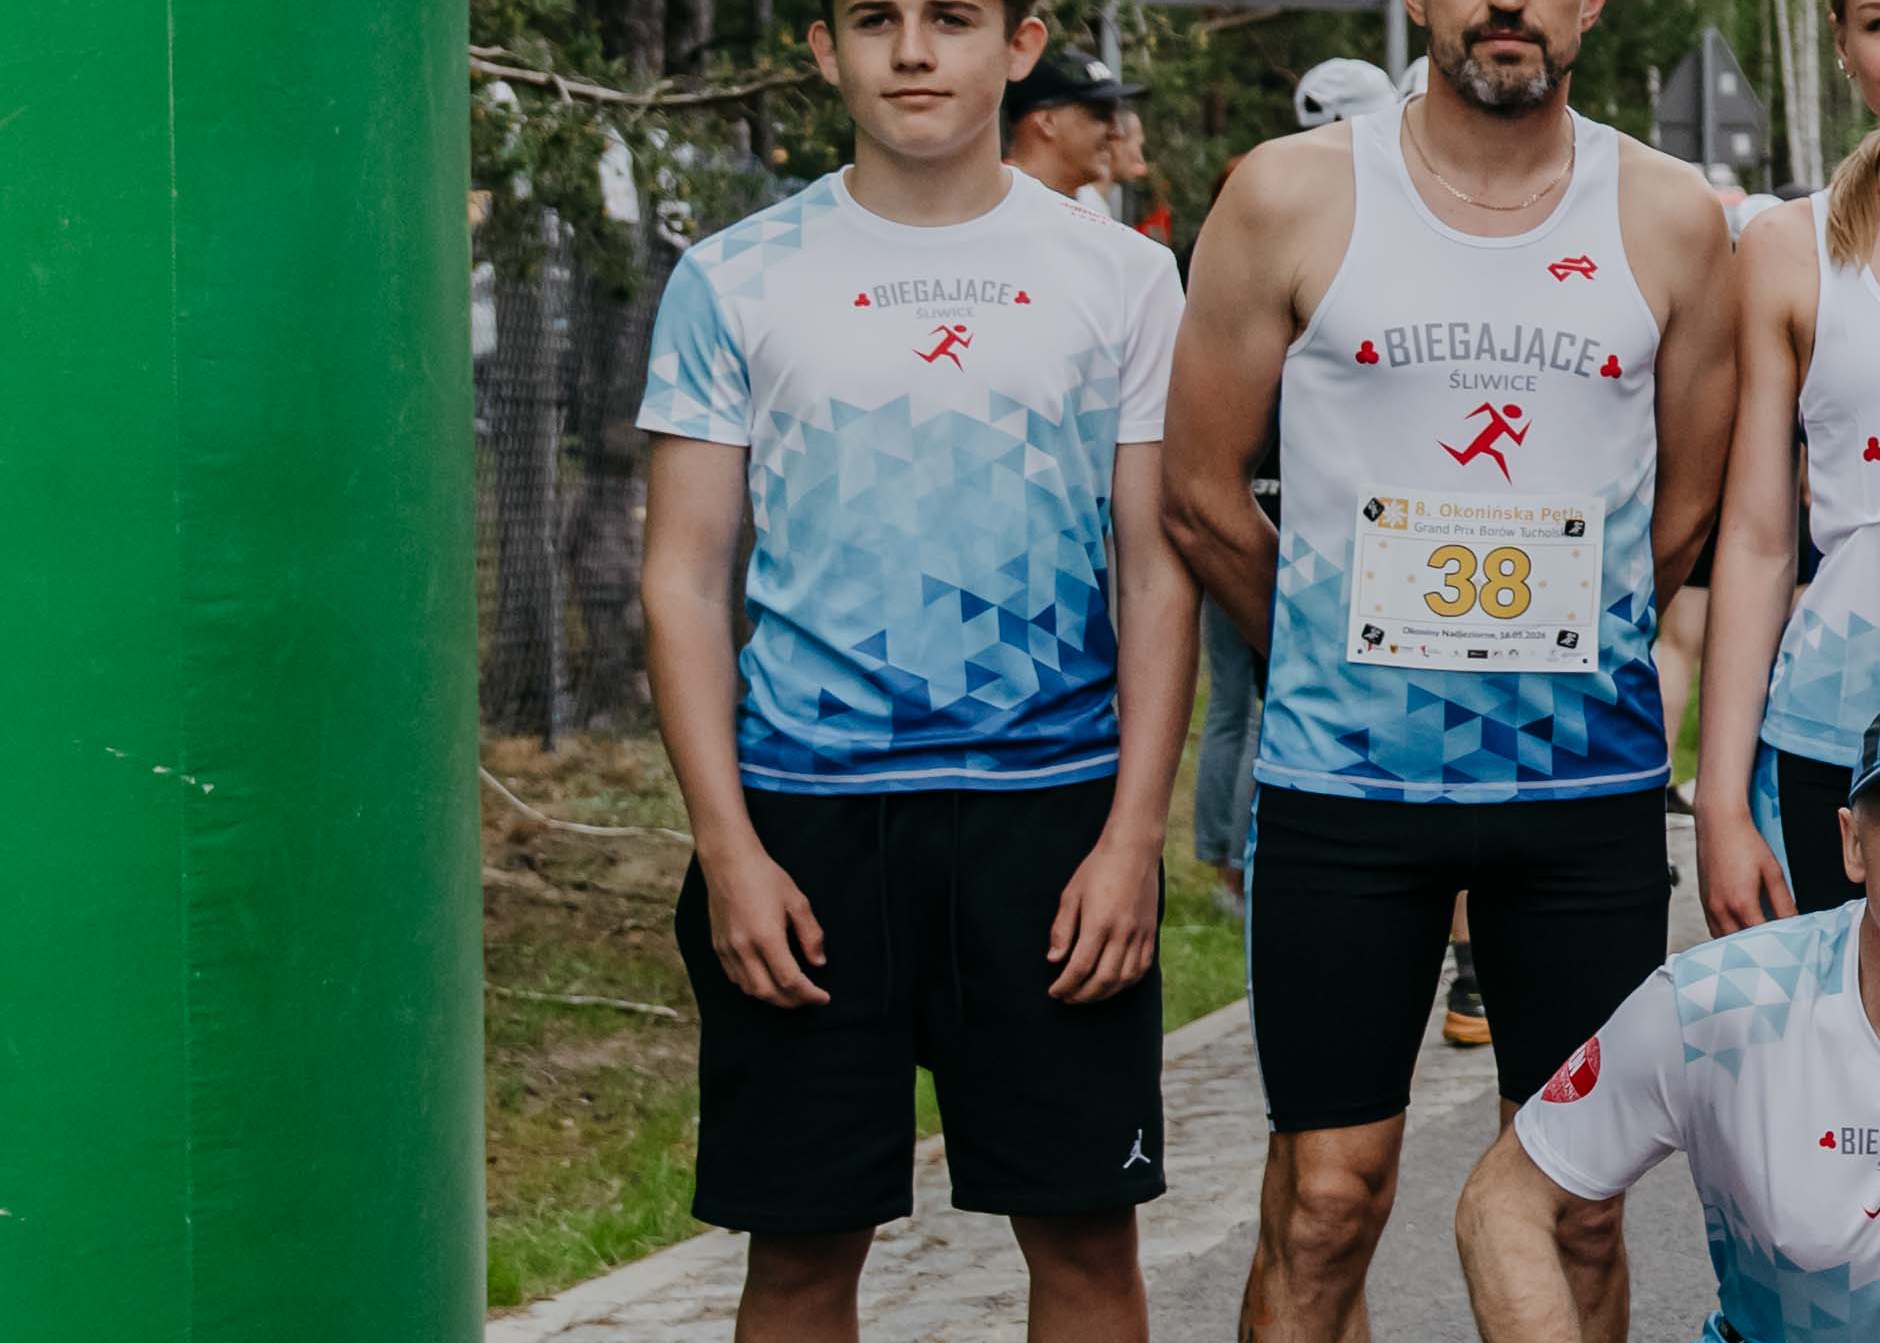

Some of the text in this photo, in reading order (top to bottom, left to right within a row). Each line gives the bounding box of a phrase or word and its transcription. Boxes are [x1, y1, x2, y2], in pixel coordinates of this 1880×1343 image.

[872, 278, 1013, 308] BIEGAJĄCE
[1384, 322, 1601, 378] BIEGAJĄCE
[1449, 369, 1537, 392] ŚLIWICE
[1414, 502, 1431, 517] 8.
[1414, 521, 1565, 539] Grand Prix Borów Tucholsk
[1423, 544, 1532, 620] 38
